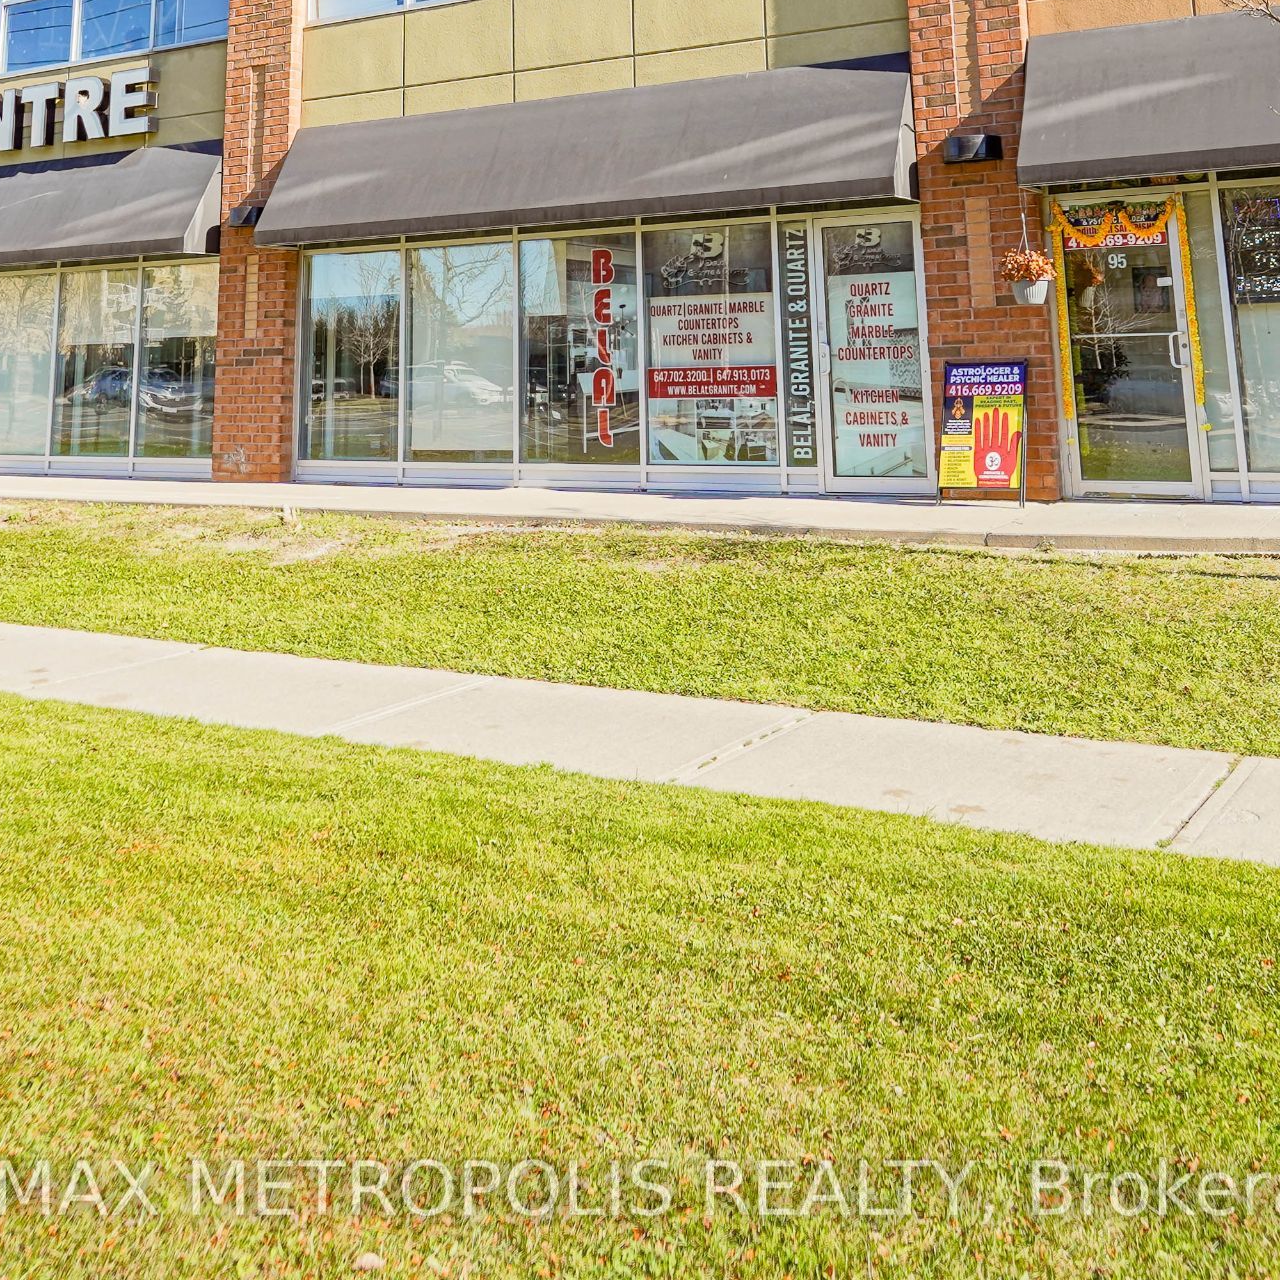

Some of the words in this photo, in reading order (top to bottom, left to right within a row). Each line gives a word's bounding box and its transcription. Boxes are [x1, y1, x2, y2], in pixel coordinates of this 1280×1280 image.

[1089, 216, 1117, 225] PSYC
[1068, 233, 1162, 247] 4169-9209
[785, 227, 808, 296] QUARTZ
[1107, 254, 1127, 269] 95
[850, 282, 891, 297] QUARTZ
[650, 304, 683, 317] QUARTZ
[687, 302, 723, 316] GRANITE
[728, 301, 765, 314] MARBLE
[788, 297, 807, 313] &
[849, 304, 894, 318] GRANITE
[678, 317, 740, 331] COUNTERTOPS
[662, 333, 699, 346] KITCHEN
[701, 333, 744, 345] CABINETS
[746, 332, 753, 344] &
[850, 325, 894, 339] MARBLE
[591, 248, 616, 447] BELAL
[692, 348, 723, 361] VANITY
[838, 346, 914, 361] COUNTERTOPS
[788, 318, 813, 397] GRANITE
[653, 370, 707, 382] 647.702.3200
[716, 369, 771, 382] 647.913.0173
[951, 367, 1011, 376] ASTROLOGER
[1013, 366, 1020, 374] &
[950, 375, 986, 384] PSYCHIC
[852, 389, 899, 403] KITCHEN
[949, 384, 1022, 396] 416.669.9209
[845, 411, 897, 425] CABINETS
[901, 411, 909, 425] &
[790, 399, 813, 460] BELAL
[859, 434, 897, 447] VANITY
